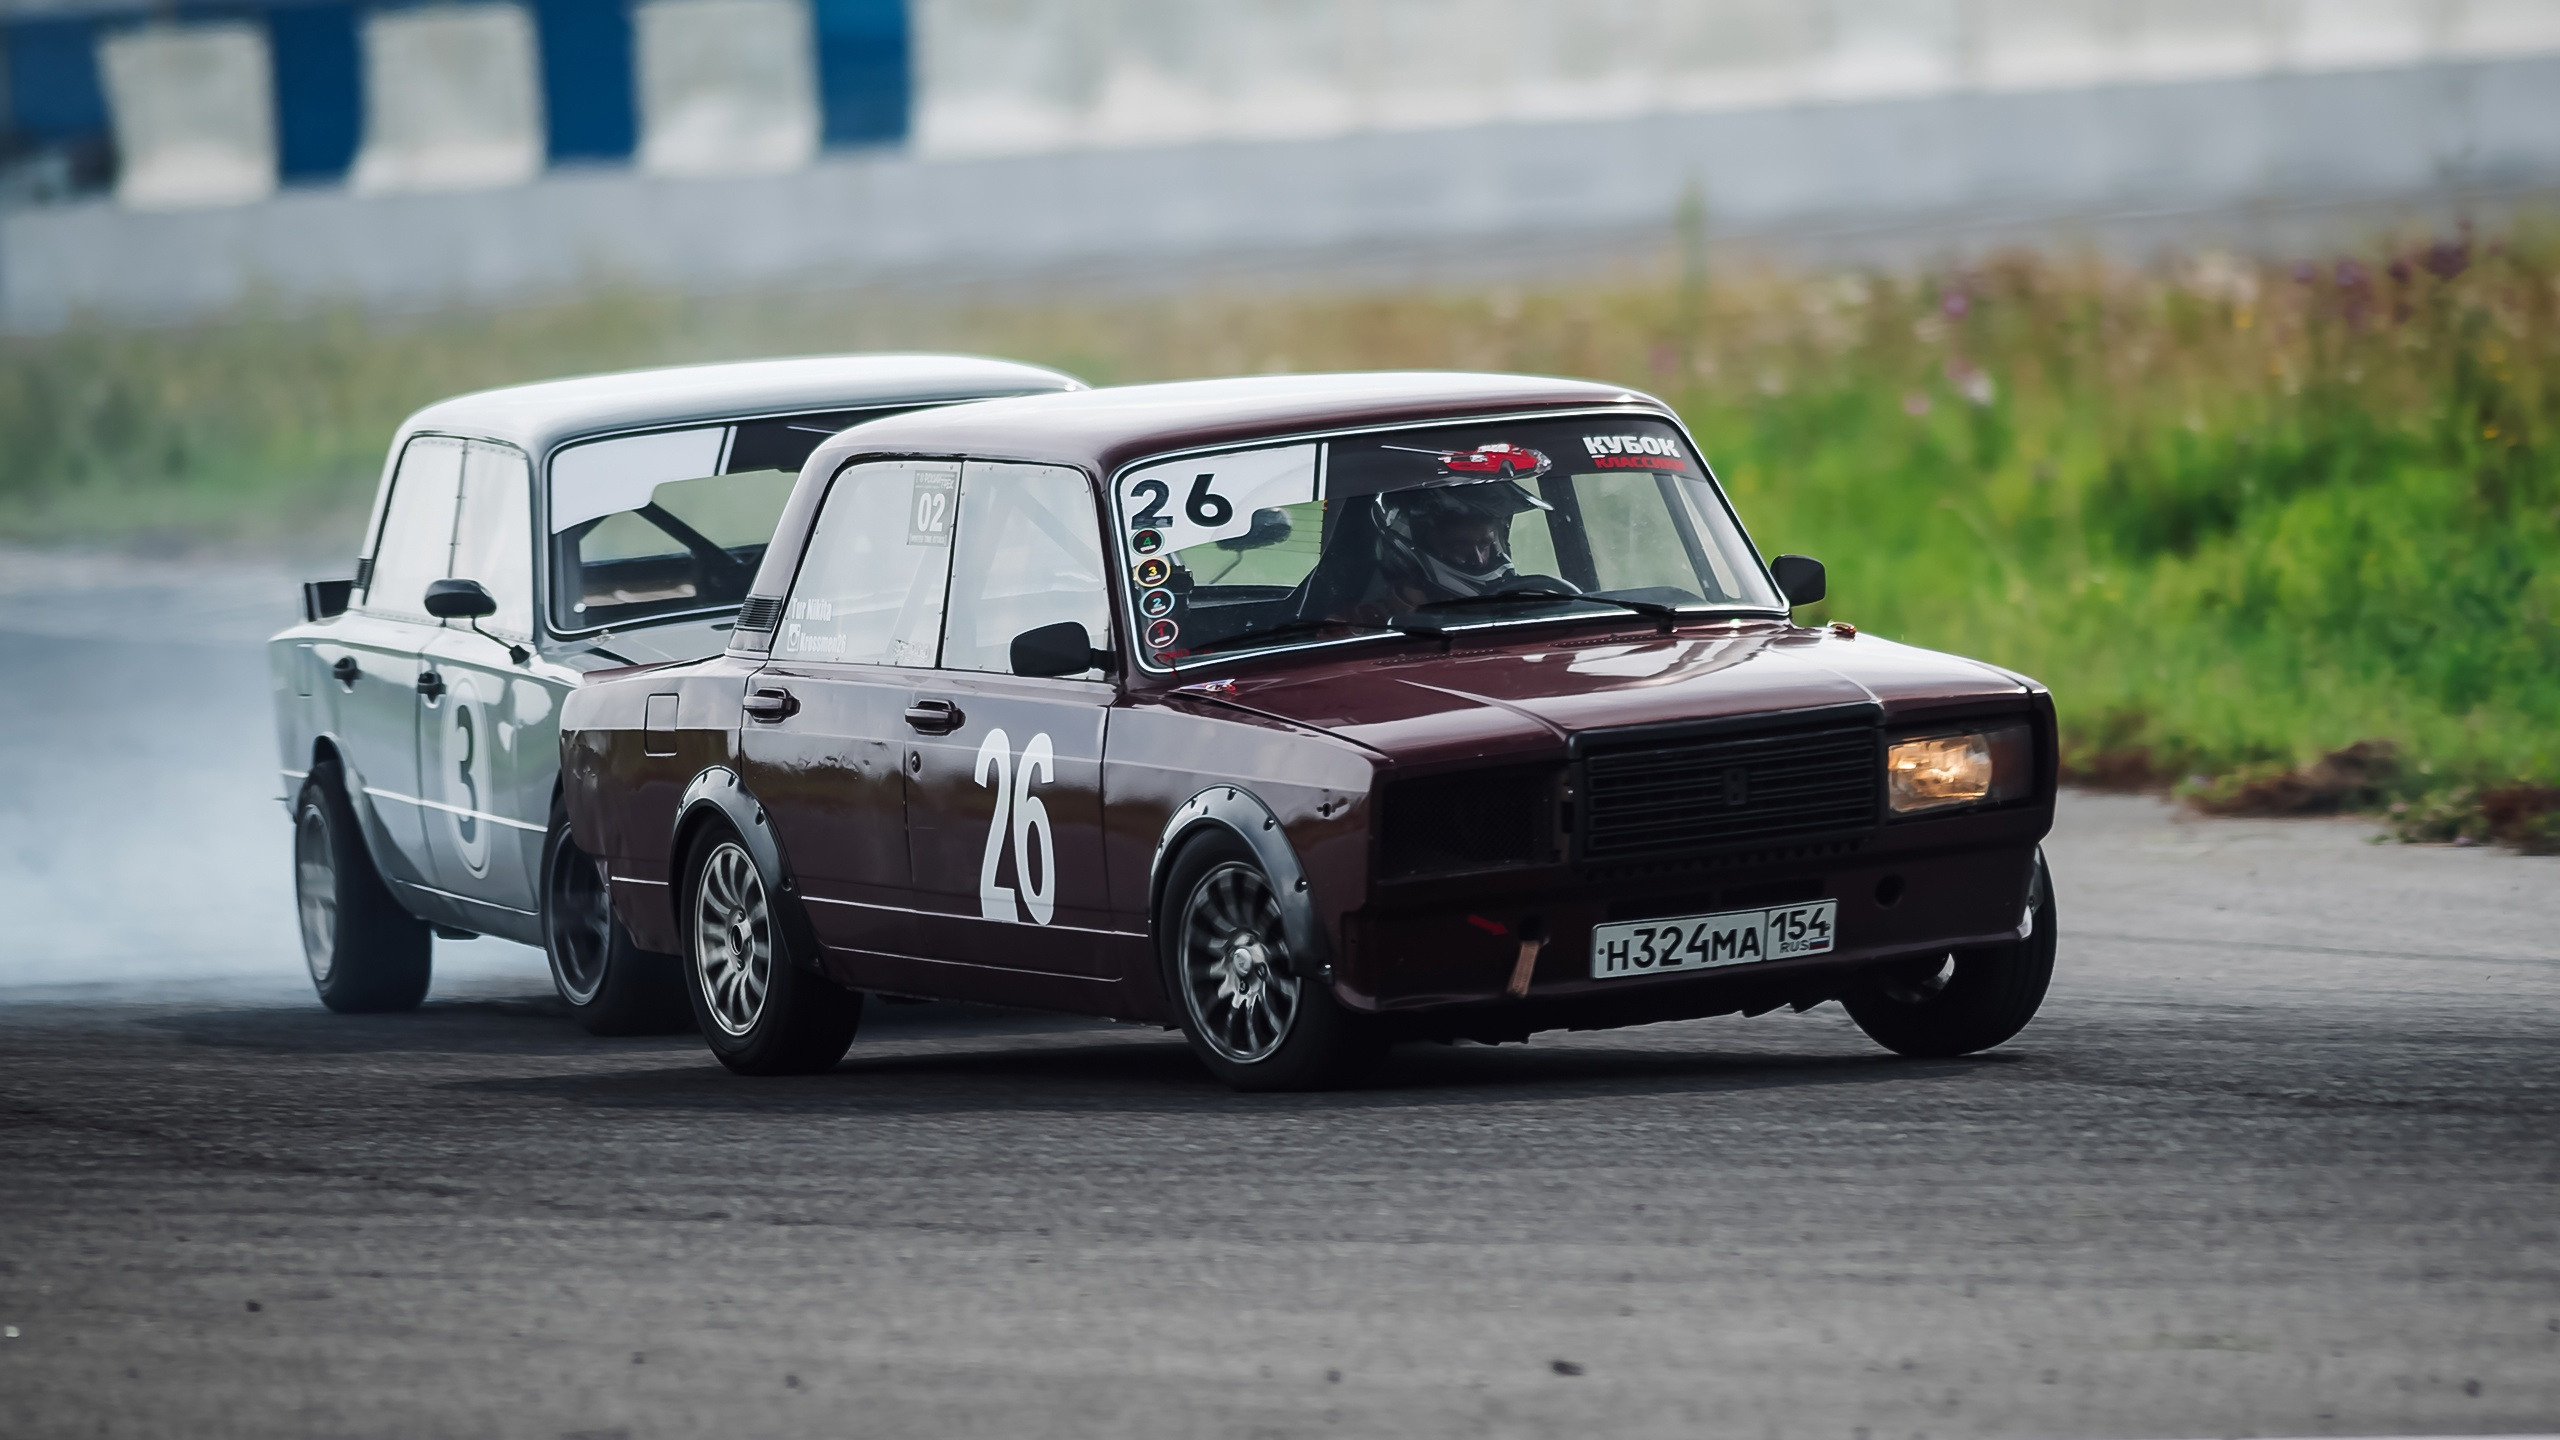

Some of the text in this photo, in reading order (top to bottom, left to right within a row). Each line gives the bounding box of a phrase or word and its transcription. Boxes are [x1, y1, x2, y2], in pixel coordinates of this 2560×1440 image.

[1582, 435, 1682, 459] КУБОК
[917, 492, 946, 532] 02
[1130, 473, 1234, 531] 26
[1143, 536, 1152, 546] 4
[1148, 566, 1158, 577] 3
[807, 599, 832, 622] Nikita
[1153, 598, 1163, 608] 2
[456, 704, 478, 845] 3
[973, 727, 1056, 927] 26
[1769, 907, 1826, 943] 154
[1779, 940, 1809, 954] RUS
